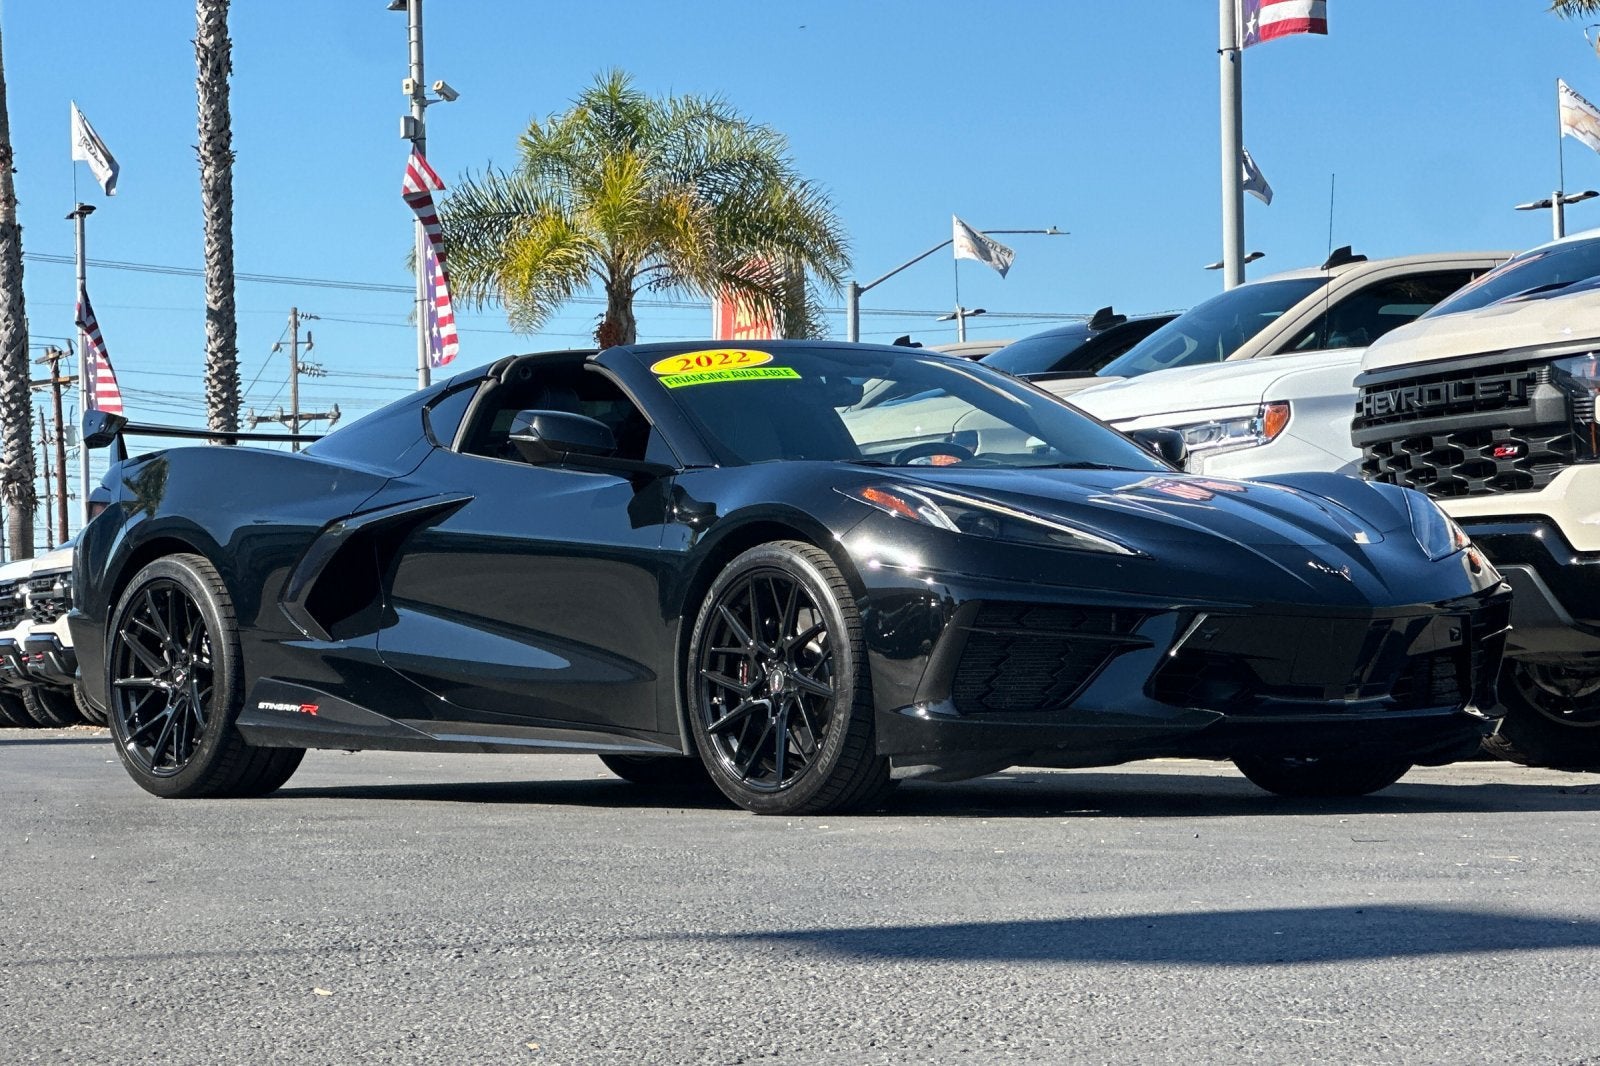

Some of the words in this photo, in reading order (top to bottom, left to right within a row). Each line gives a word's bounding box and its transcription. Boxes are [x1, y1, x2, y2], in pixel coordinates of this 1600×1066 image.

[677, 352, 751, 371] 2022
[665, 371, 731, 386] FINANCING
[731, 369, 795, 378] AVAILABLE
[257, 702, 301, 712] STINGRAY
